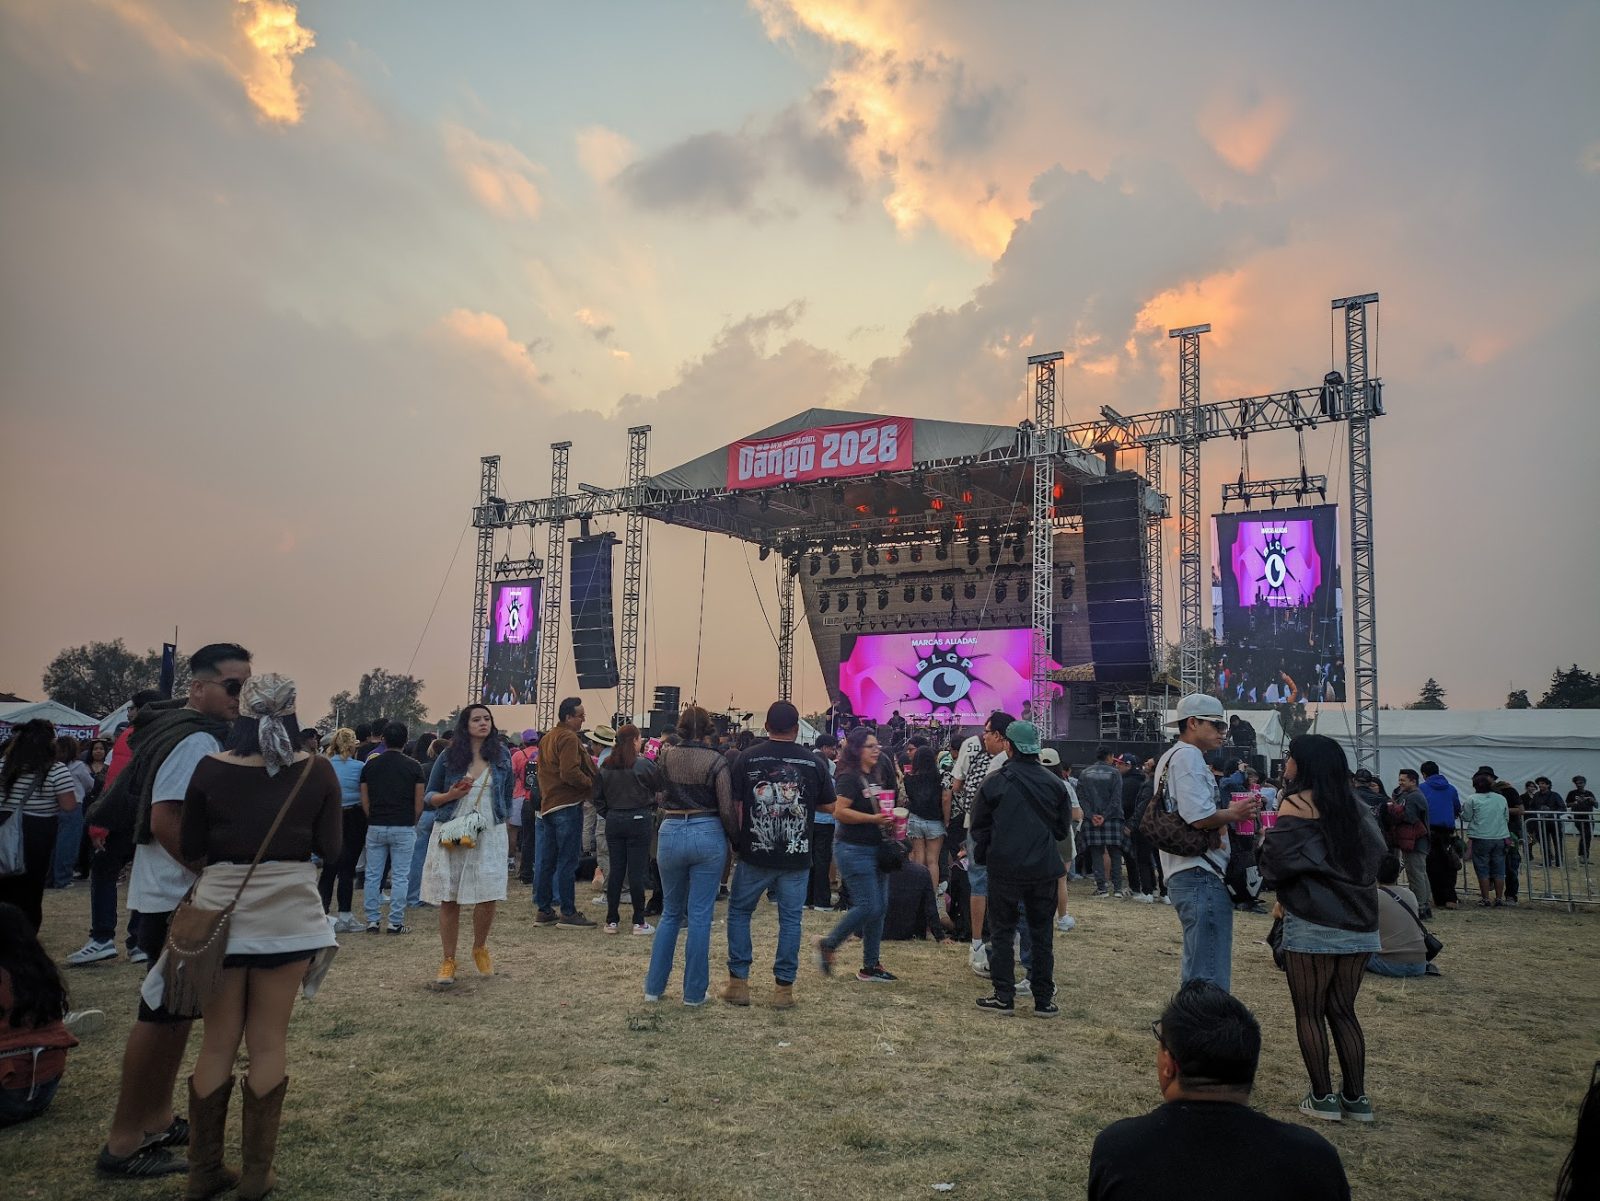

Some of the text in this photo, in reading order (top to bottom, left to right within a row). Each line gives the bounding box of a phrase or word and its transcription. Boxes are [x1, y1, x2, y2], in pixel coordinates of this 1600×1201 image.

[821, 424, 898, 469] 2026
[911, 637, 978, 647] MARCAS ALIADAS
